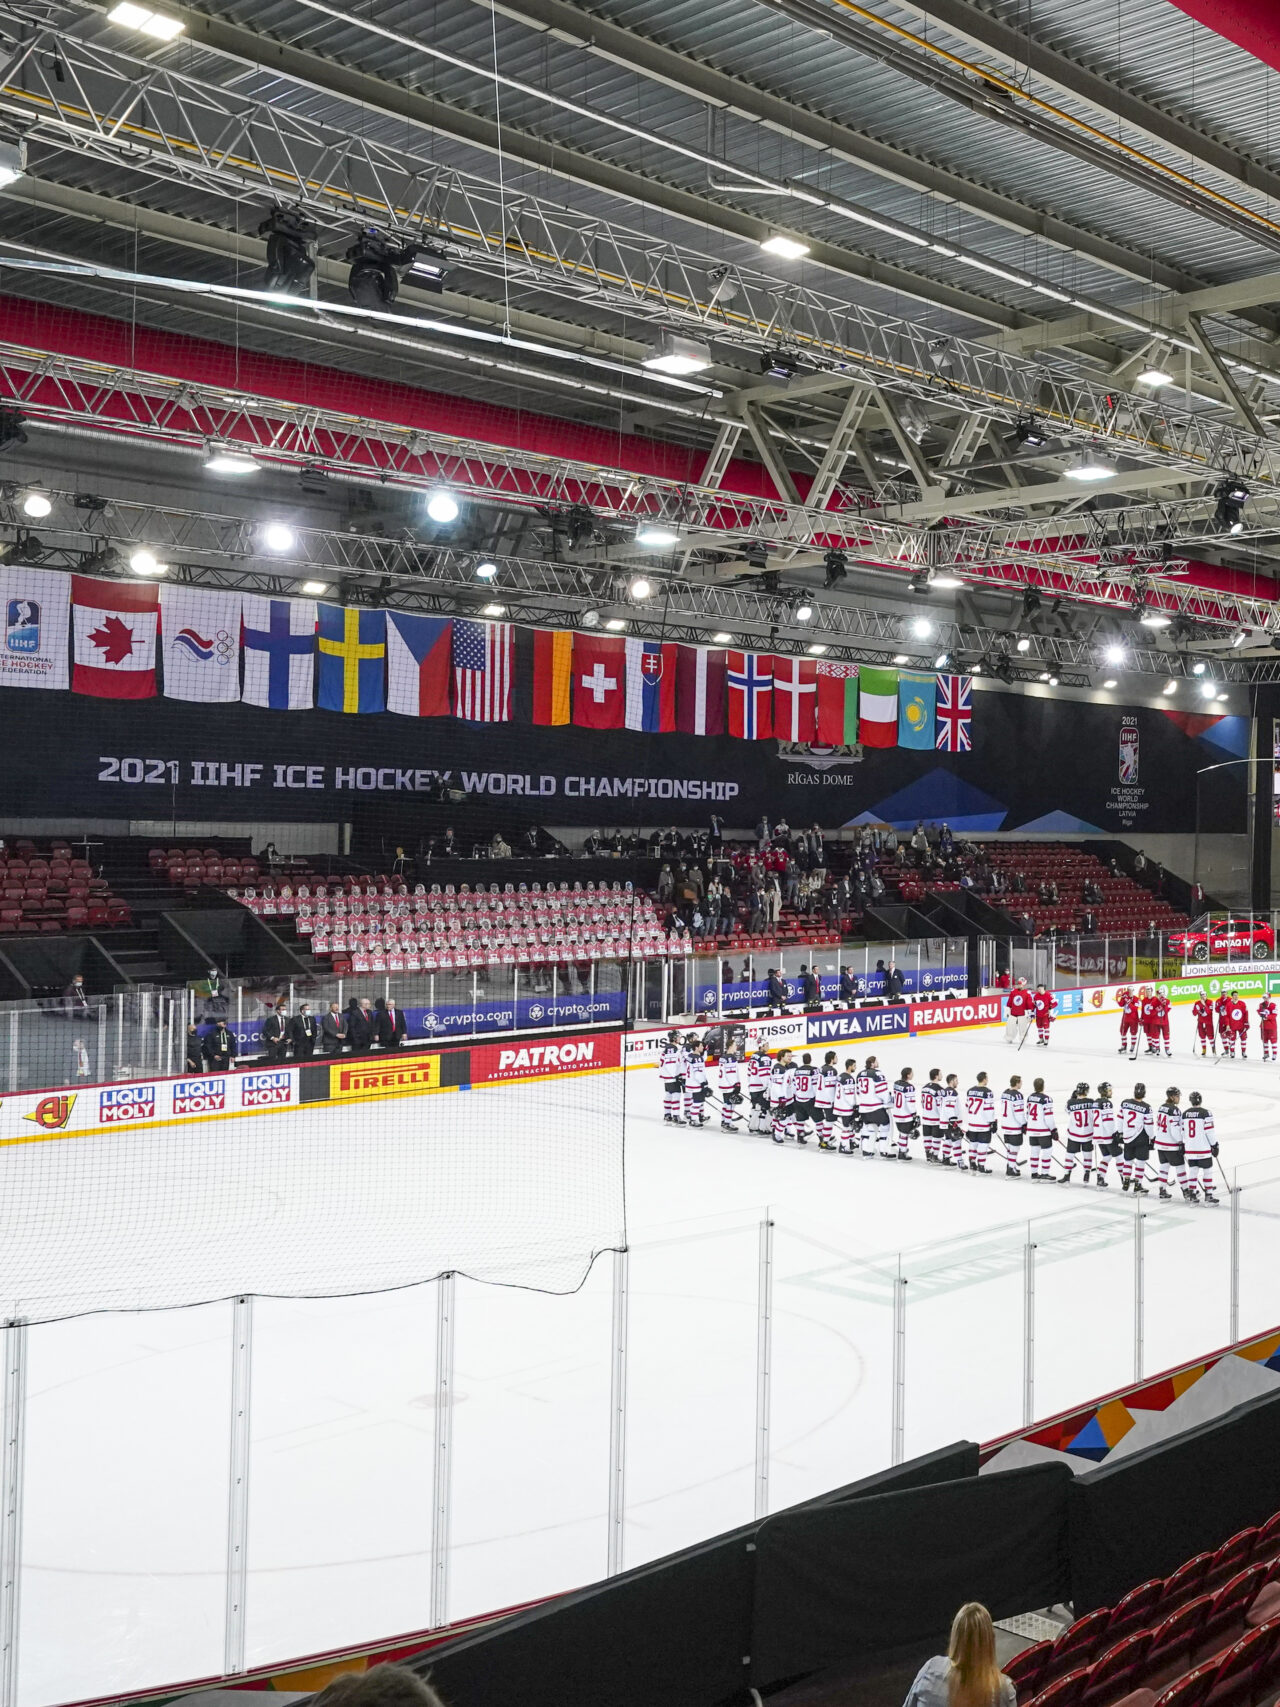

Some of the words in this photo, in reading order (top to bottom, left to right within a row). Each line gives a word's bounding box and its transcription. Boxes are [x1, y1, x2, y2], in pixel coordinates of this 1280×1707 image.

[10, 638, 36, 648] IIHF
[0, 654, 53, 663] TERNATIONAL
[11, 660, 54, 669] HOCKEY
[1121, 716, 1138, 725] 2021
[1122, 733, 1137, 742] IIHF
[99, 757, 179, 784] 2021
[191, 761, 263, 787] IIHF
[273, 764, 325, 789] ICE
[335, 767, 452, 792] HOCKEY
[461, 771, 556, 796] WORLD
[564, 776, 739, 801] CHAMPIONSHIP
[788, 771, 820, 785] RĪGAS
[822, 774, 854, 786] DOME
[1110, 787, 1121, 796] ICE
[1122, 788, 1145, 796] HOCKEY
[1117, 795, 1138, 803] WORLD
[1105, 802, 1149, 810] CHAMPIONSHIP
[1214, 938, 1241, 949] ENYAQ
[1187, 966, 1207, 975] JOIN
[934, 973, 968, 986] crypto.co
[1222, 978, 1262, 991] ŠKODA
[1171, 983, 1205, 996] ŠKODA
[547, 1002, 610, 1017] crypto.com
[914, 1003, 998, 1026] REAUTO.RU
[443, 1010, 513, 1026] crypto.com
[759, 1023, 803, 1036] TISSOT
[808, 1018, 862, 1039] NIVEA
[867, 1013, 907, 1032] MEN
[499, 1041, 595, 1070] PATRON
[340, 1062, 430, 1091] PIRELLI
[488, 1067, 550, 1079] АВТОЗАПЧАСТИ
[176, 1080, 224, 1099] LIQUI
[244, 1073, 290, 1091] LIQUI
[796, 1076, 809, 1092] 38
[102, 1087, 154, 1106] LIQUI
[244, 1088, 290, 1106] MOLY
[102, 1102, 154, 1120] MOLY
[176, 1096, 224, 1114] MOLY
[968, 1097, 983, 1115] 27
[1073, 1110, 1089, 1128] 91
[1127, 1110, 1137, 1128] 2
[1188, 1119, 1196, 1138] 8
